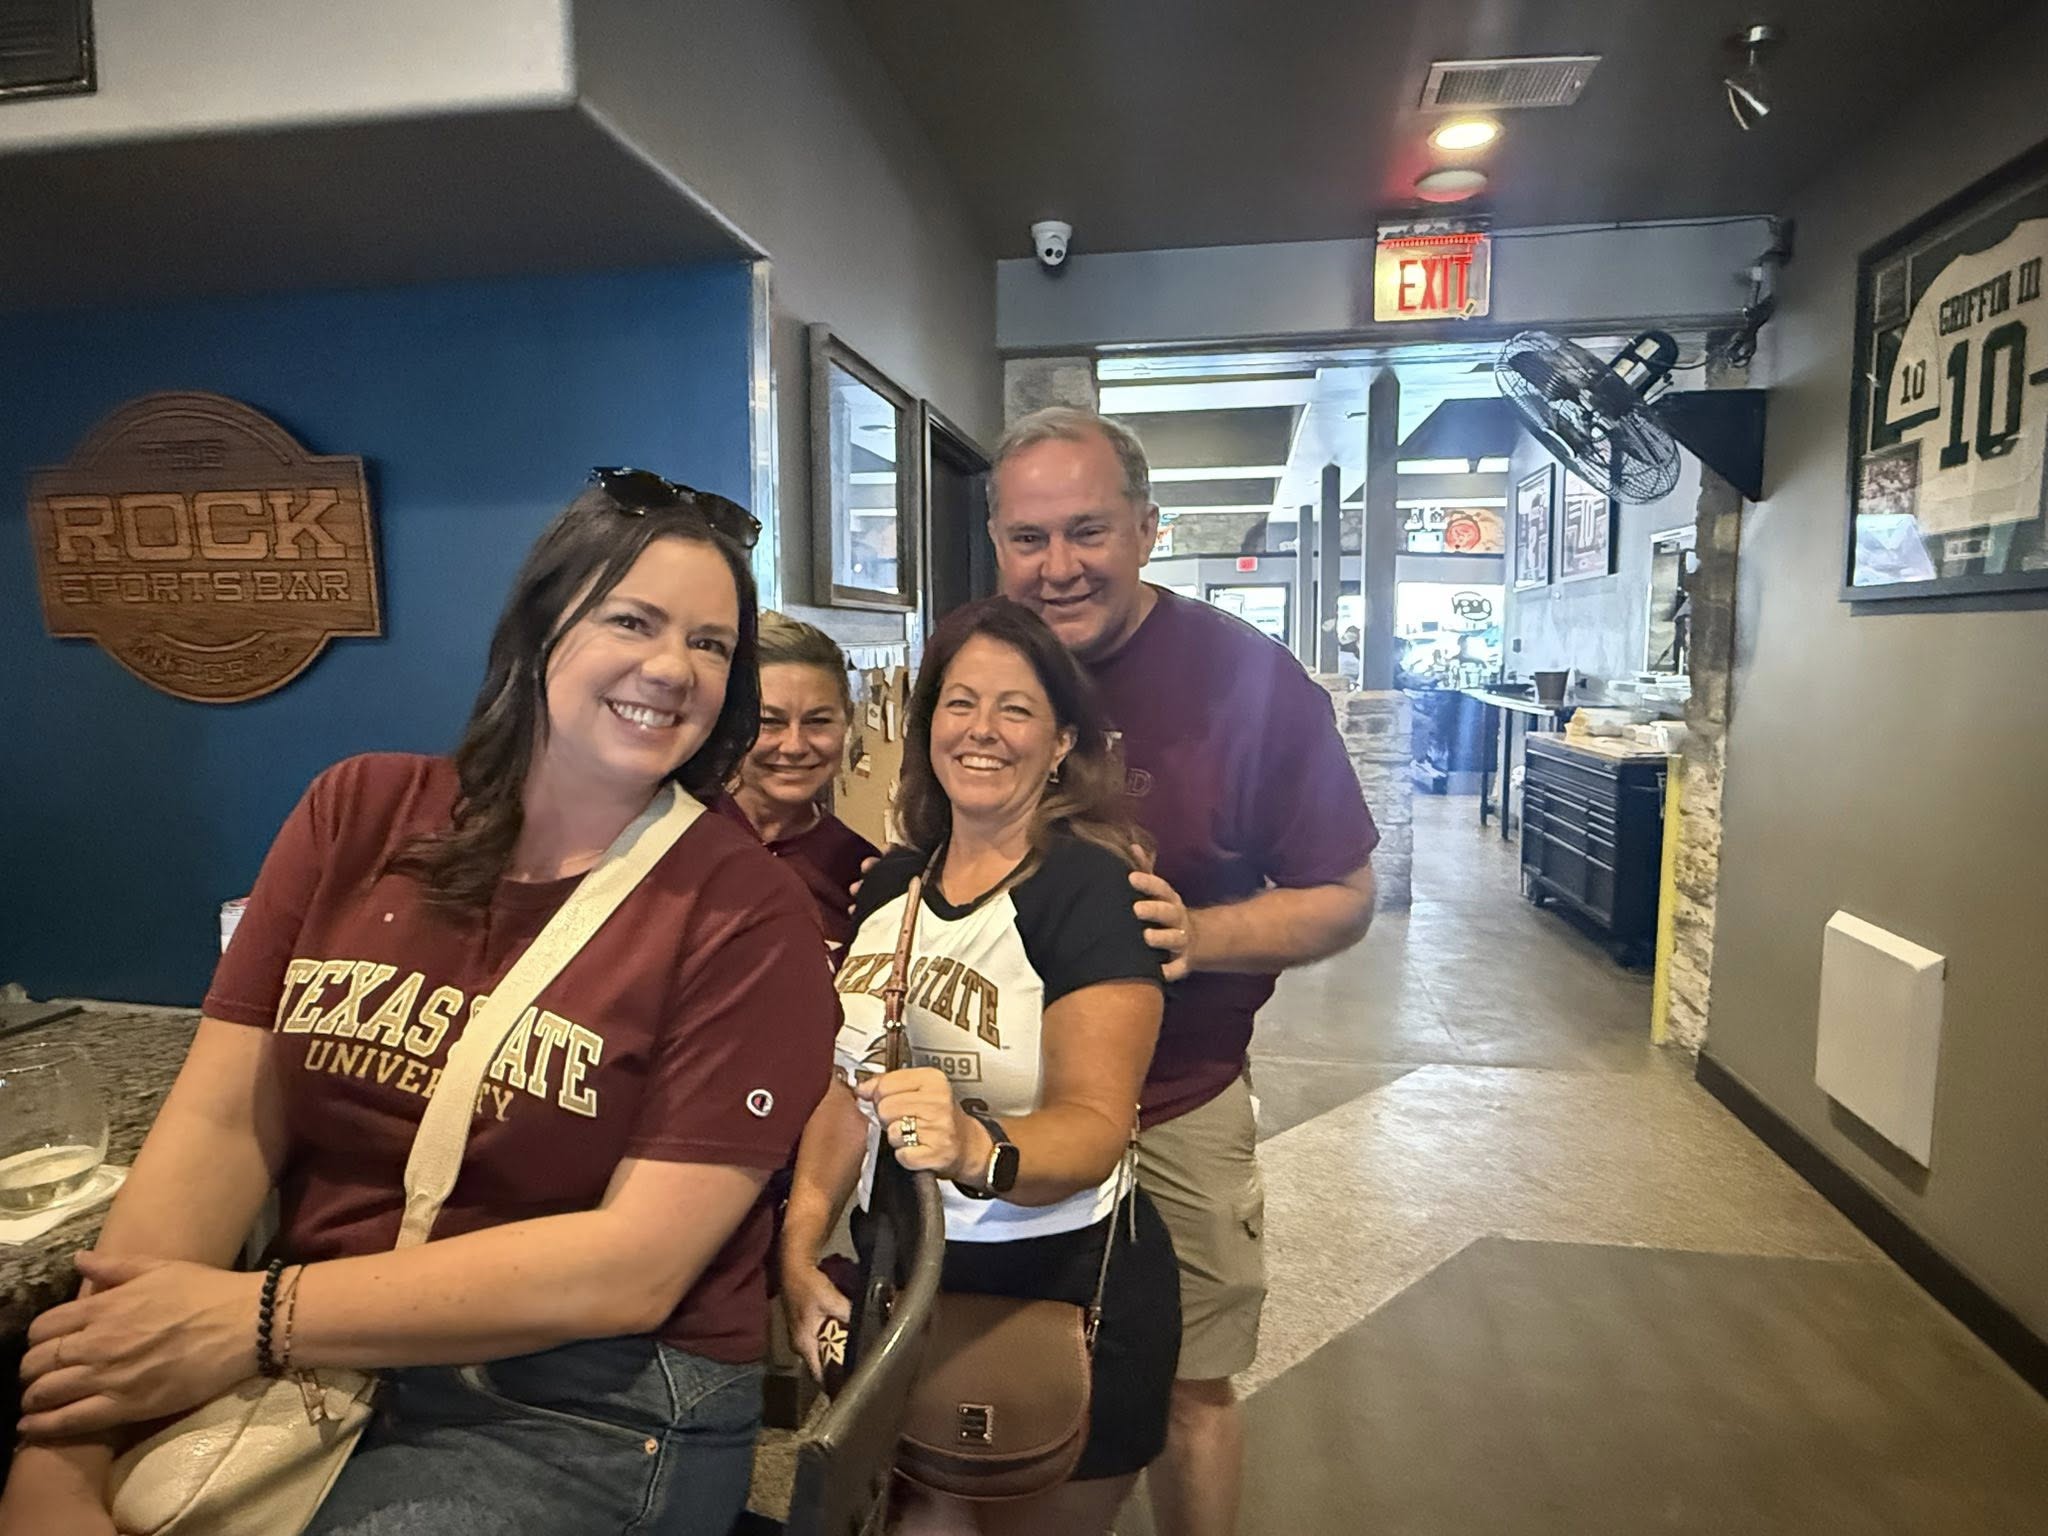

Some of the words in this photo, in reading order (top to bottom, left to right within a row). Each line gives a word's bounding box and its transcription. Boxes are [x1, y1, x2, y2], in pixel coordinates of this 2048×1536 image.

[1398, 255, 1473, 312] EXIT
[1940, 270, 2012, 336] GRIFFIN
[2017, 256, 2043, 305] III
[1900, 360, 1927, 404] 10
[1939, 319, 2028, 470] 10
[49, 487, 348, 564] ROCK
[58, 569, 244, 604] SPORTS
[251, 568, 350, 602] BAR
[273, 958, 464, 1058] TEXAS
